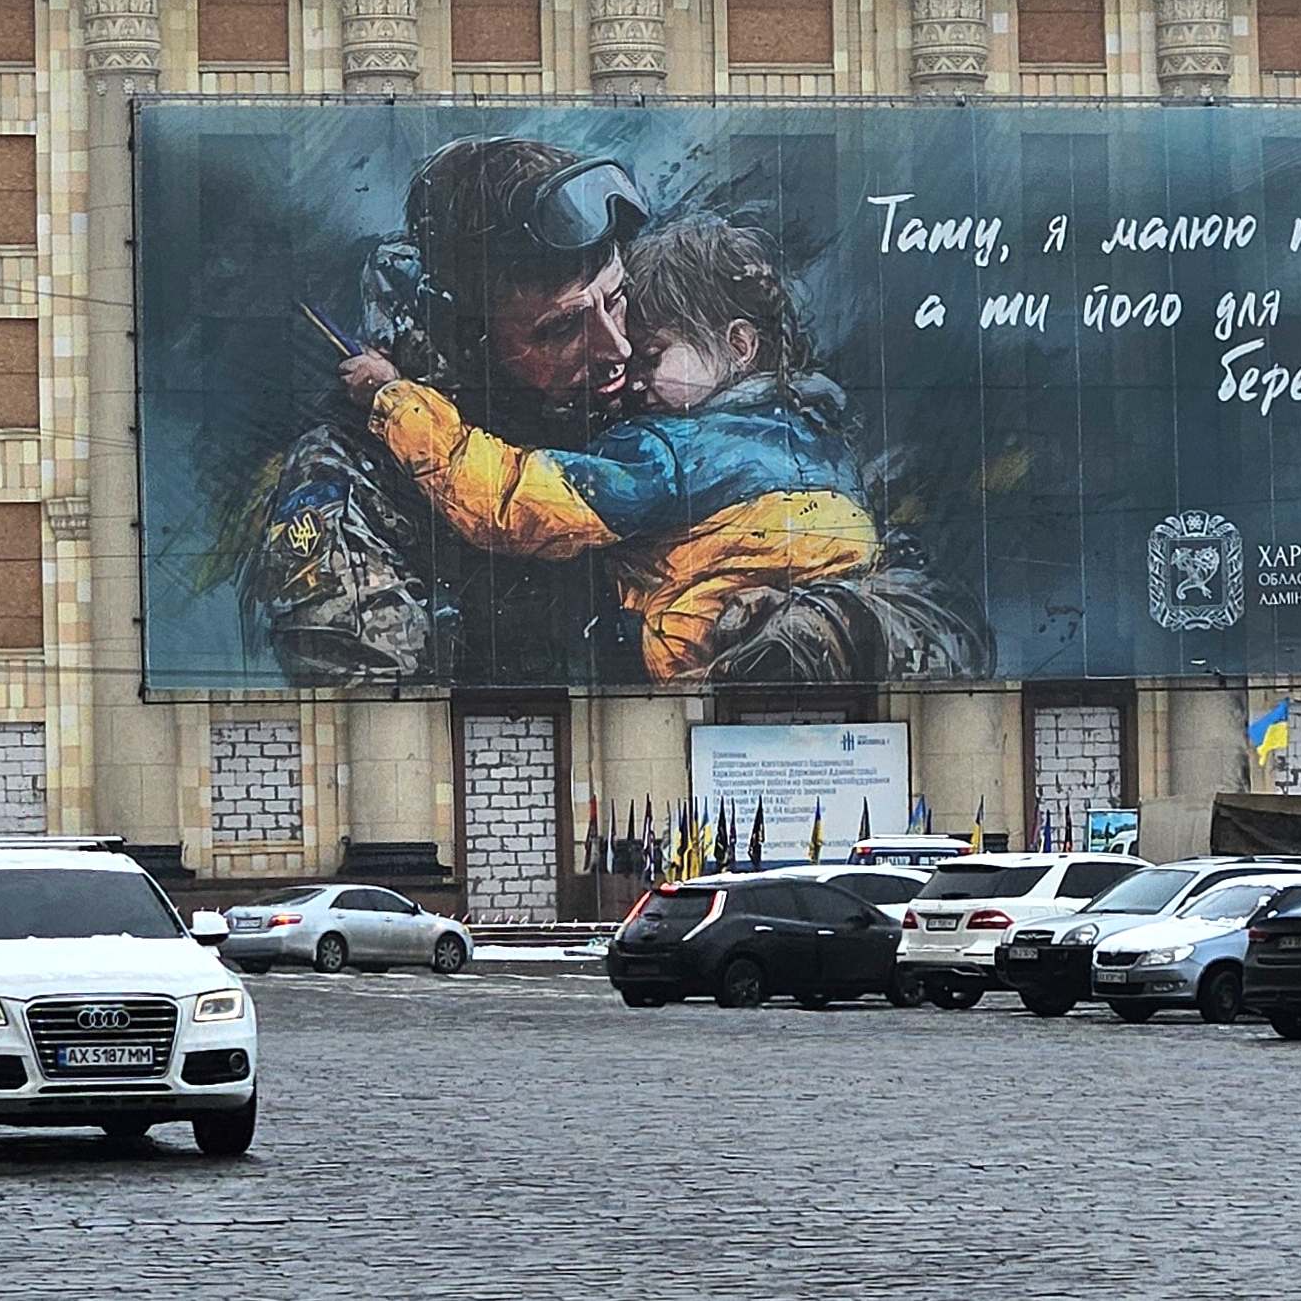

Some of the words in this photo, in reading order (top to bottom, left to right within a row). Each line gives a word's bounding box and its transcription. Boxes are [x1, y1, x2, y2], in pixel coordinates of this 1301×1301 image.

[867, 193, 1011, 266] Тату,
[1043, 214, 1068, 253] я
[1101, 214, 1257, 255] малюю
[914, 296, 946, 329] а
[979, 291, 1050, 331] ти
[1083, 285, 1181, 329] його
[1214, 289, 1280, 340] для
[68, 1049, 89, 1063] AX
[92, 1048, 125, 1063] 5187
[128, 1048, 151, 1062] MM
